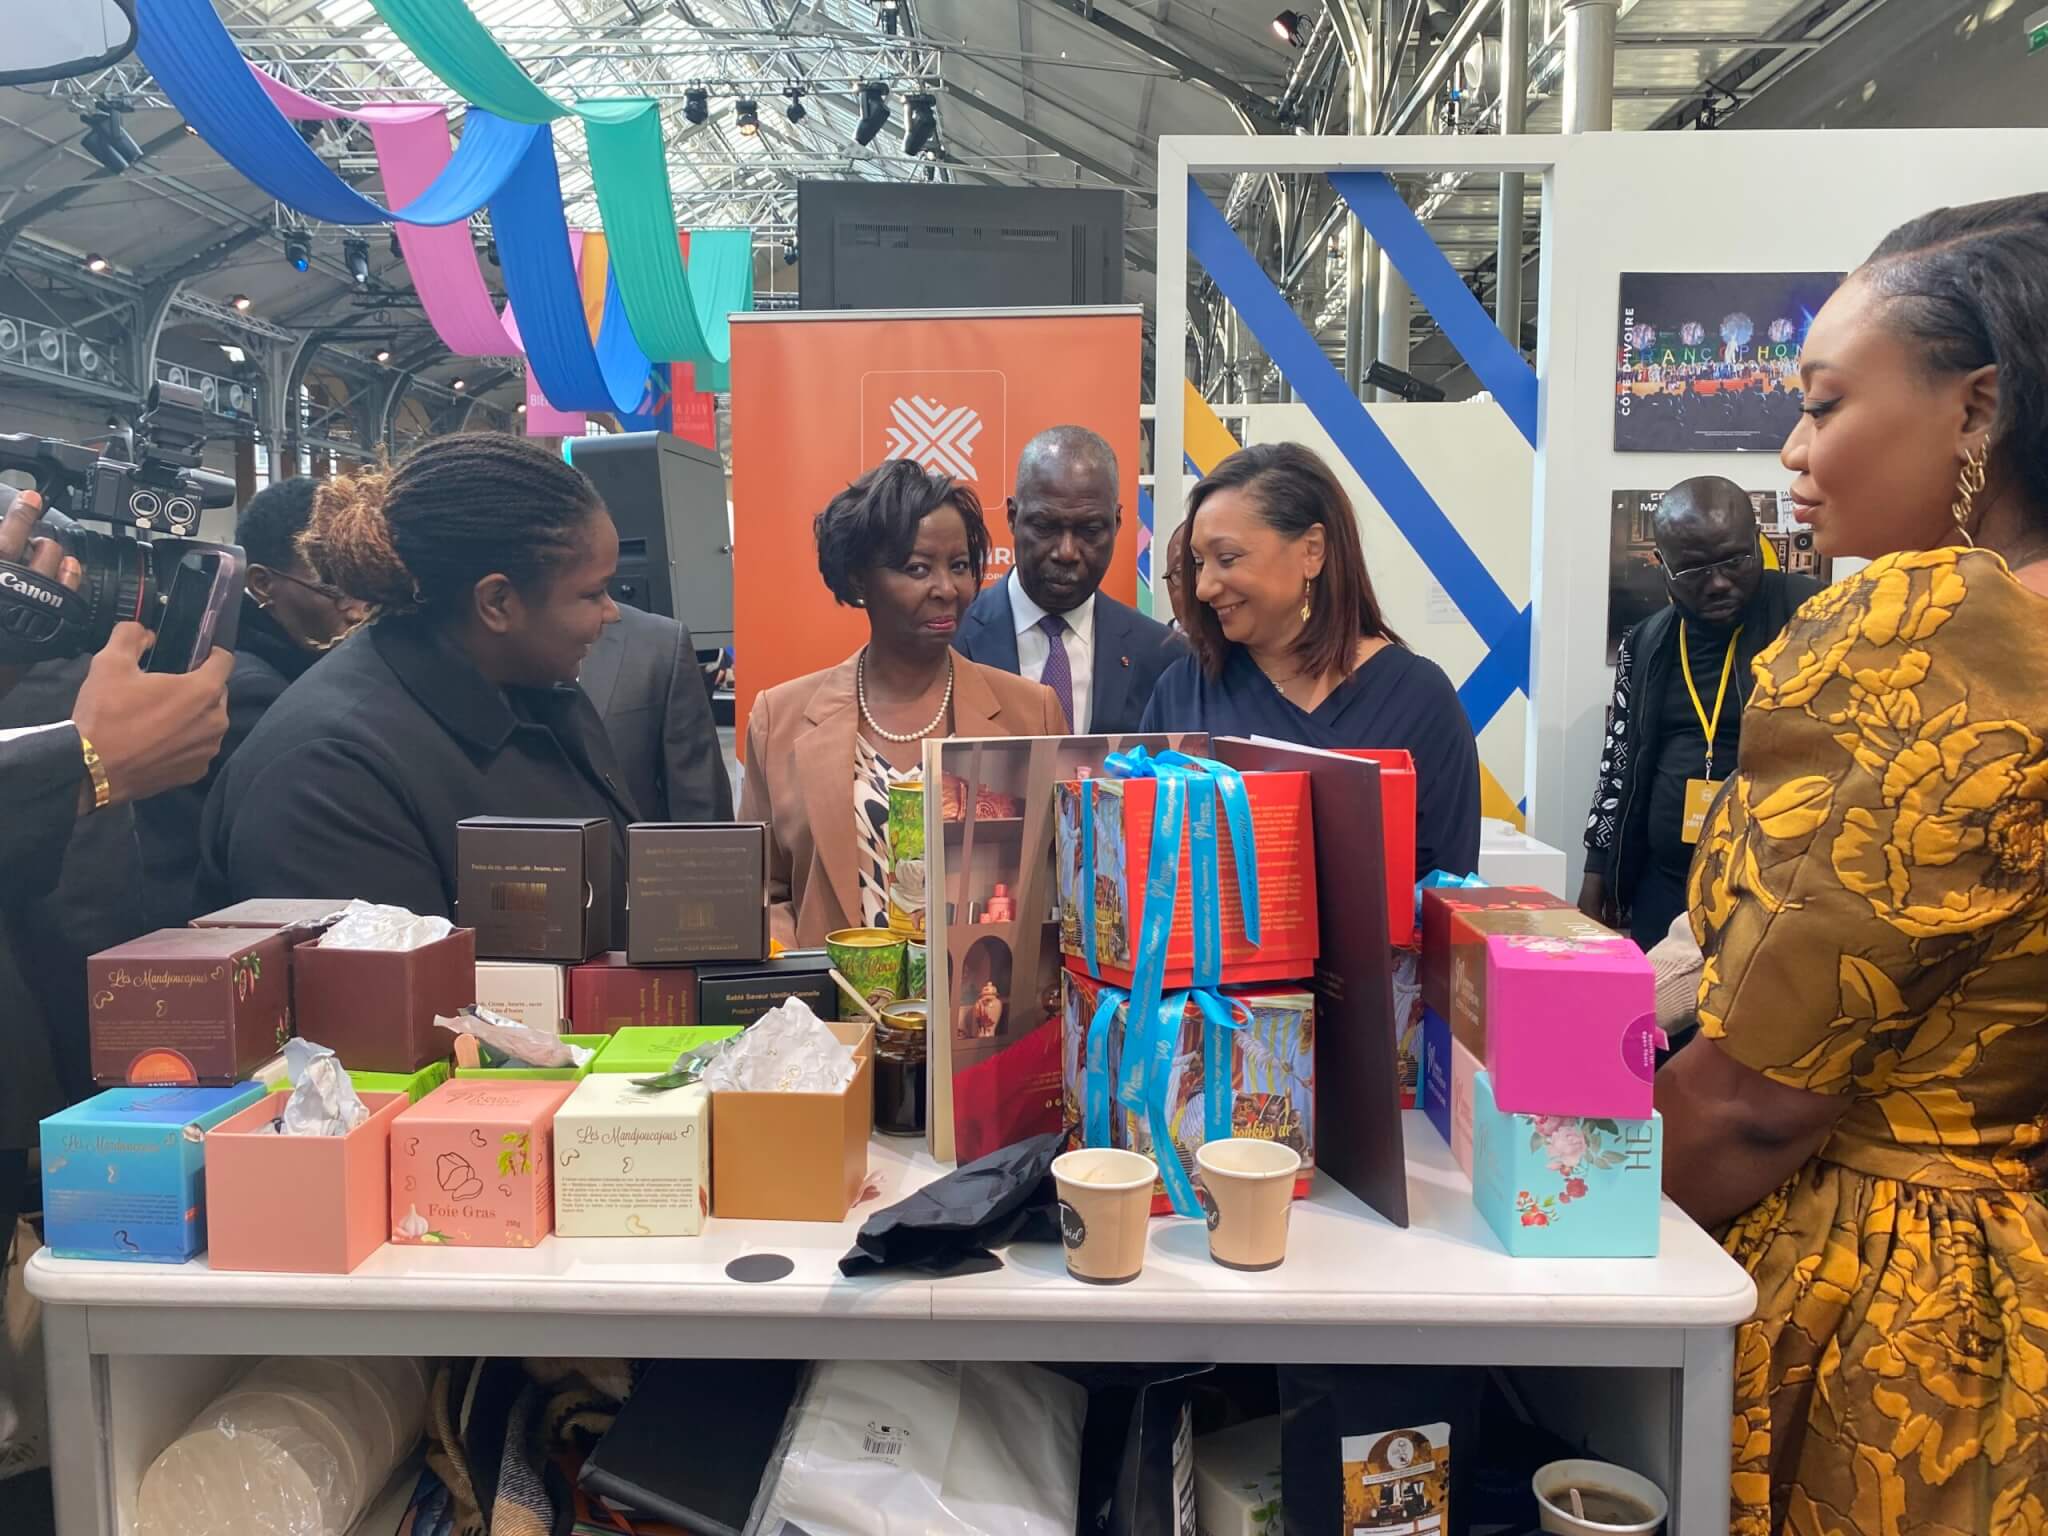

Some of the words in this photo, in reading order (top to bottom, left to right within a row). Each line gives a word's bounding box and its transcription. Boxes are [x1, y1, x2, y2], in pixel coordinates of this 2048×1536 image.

[1622, 308, 1634, 373] D'IVOIRE
[1620, 379, 1631, 416] CÔTE
[0, 572, 63, 608] Canon
[108, 968, 131, 987] Les
[576, 1125, 599, 1144] Les
[601, 1125, 678, 1148] Mandjoucajous
[429, 1203, 459, 1218] Foie
[462, 1205, 496, 1219] Gras
